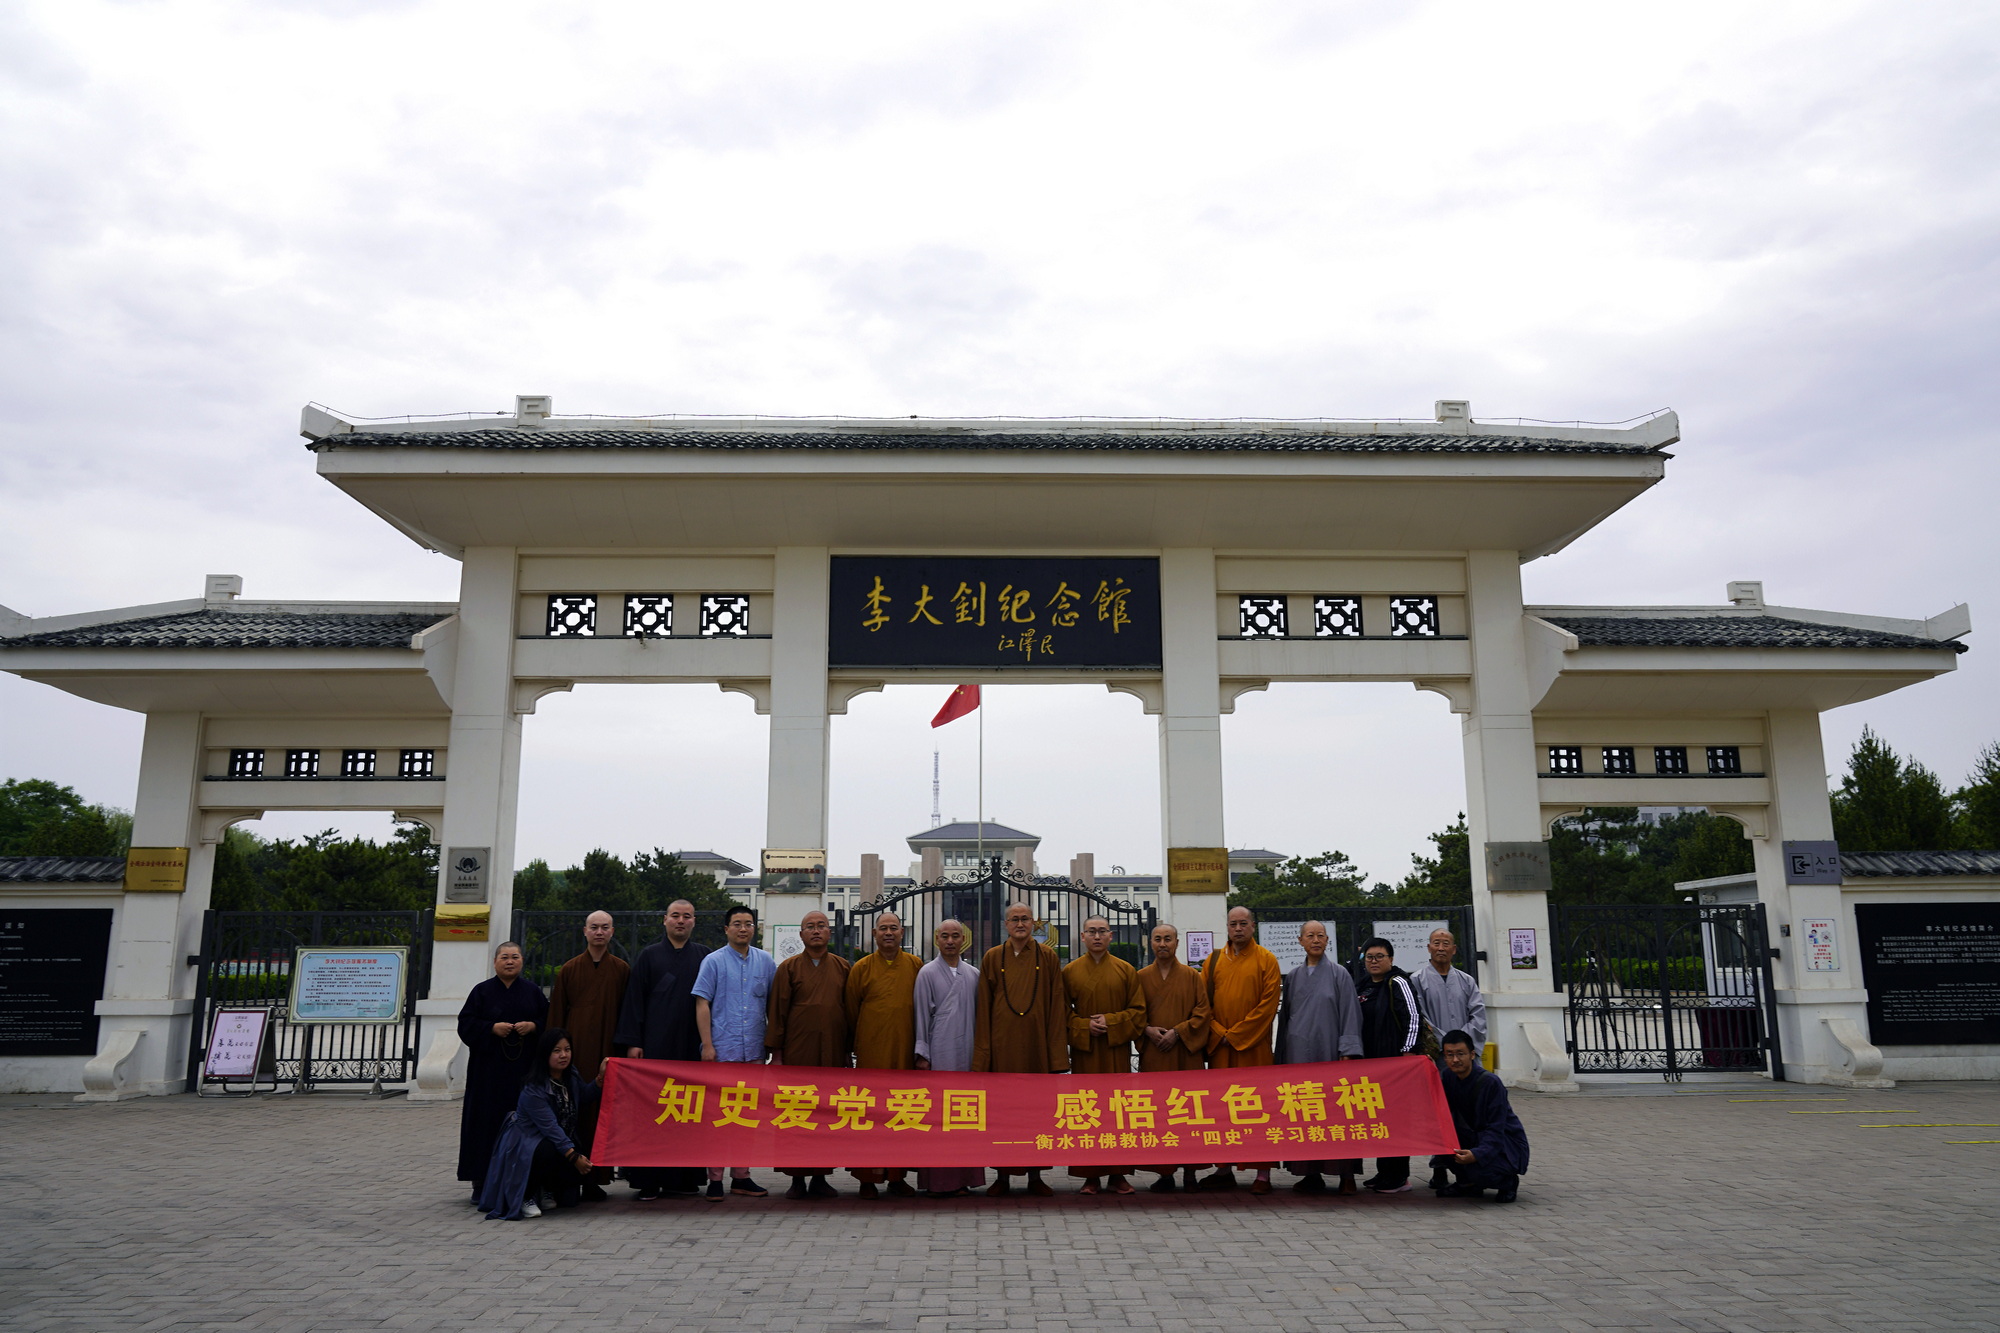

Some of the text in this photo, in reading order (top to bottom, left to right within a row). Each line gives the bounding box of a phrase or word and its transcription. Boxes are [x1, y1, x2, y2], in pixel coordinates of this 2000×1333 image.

[1815, 856, 1837, 866] 入口
[654, 1075, 1386, 1132] 知史爱党爱国 感悟红色精神
